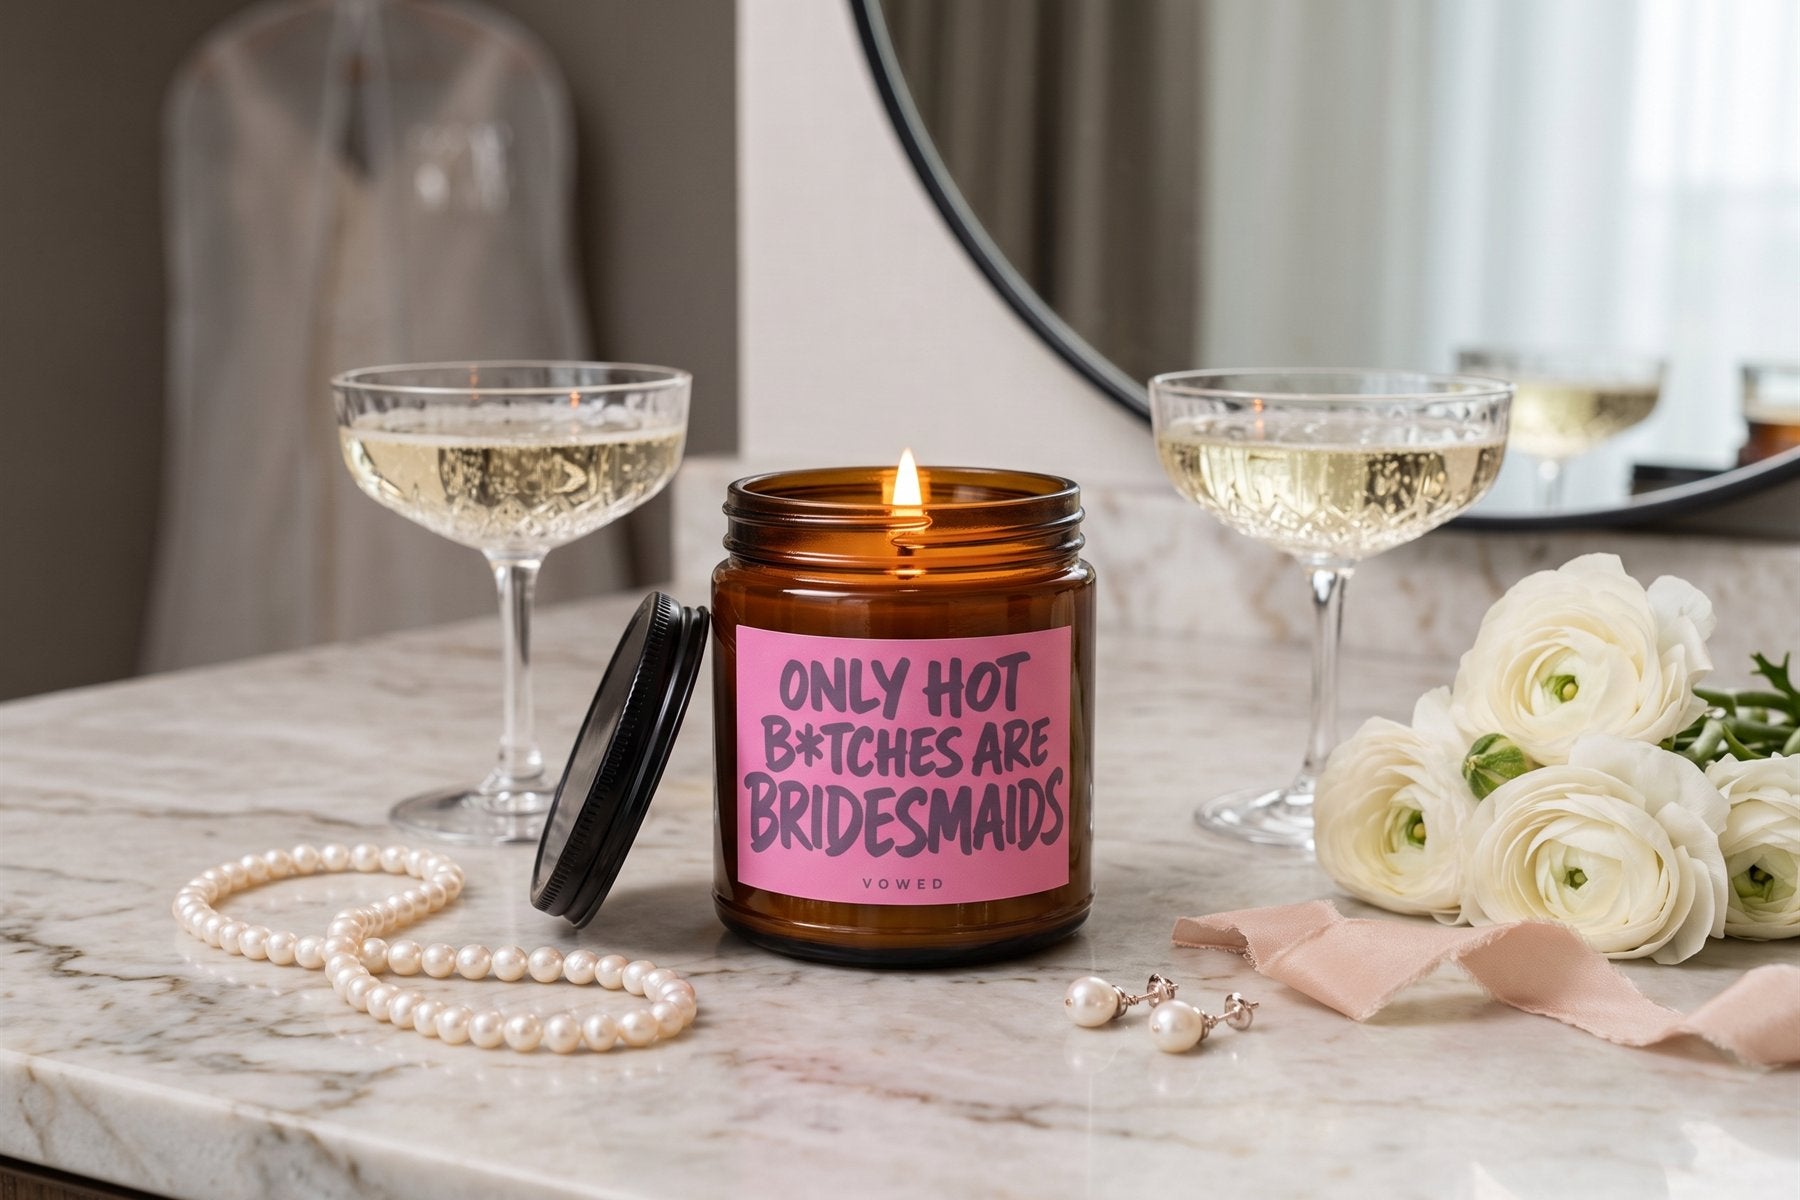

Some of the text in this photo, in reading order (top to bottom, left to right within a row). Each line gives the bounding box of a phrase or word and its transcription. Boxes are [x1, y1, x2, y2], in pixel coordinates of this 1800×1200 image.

[779, 651, 1031, 721] ONLY HOT
[971, 716, 1051, 776] ARE
[744, 766, 1065, 858] BRIDESMAIDS
[862, 877, 944, 891] VOWED
